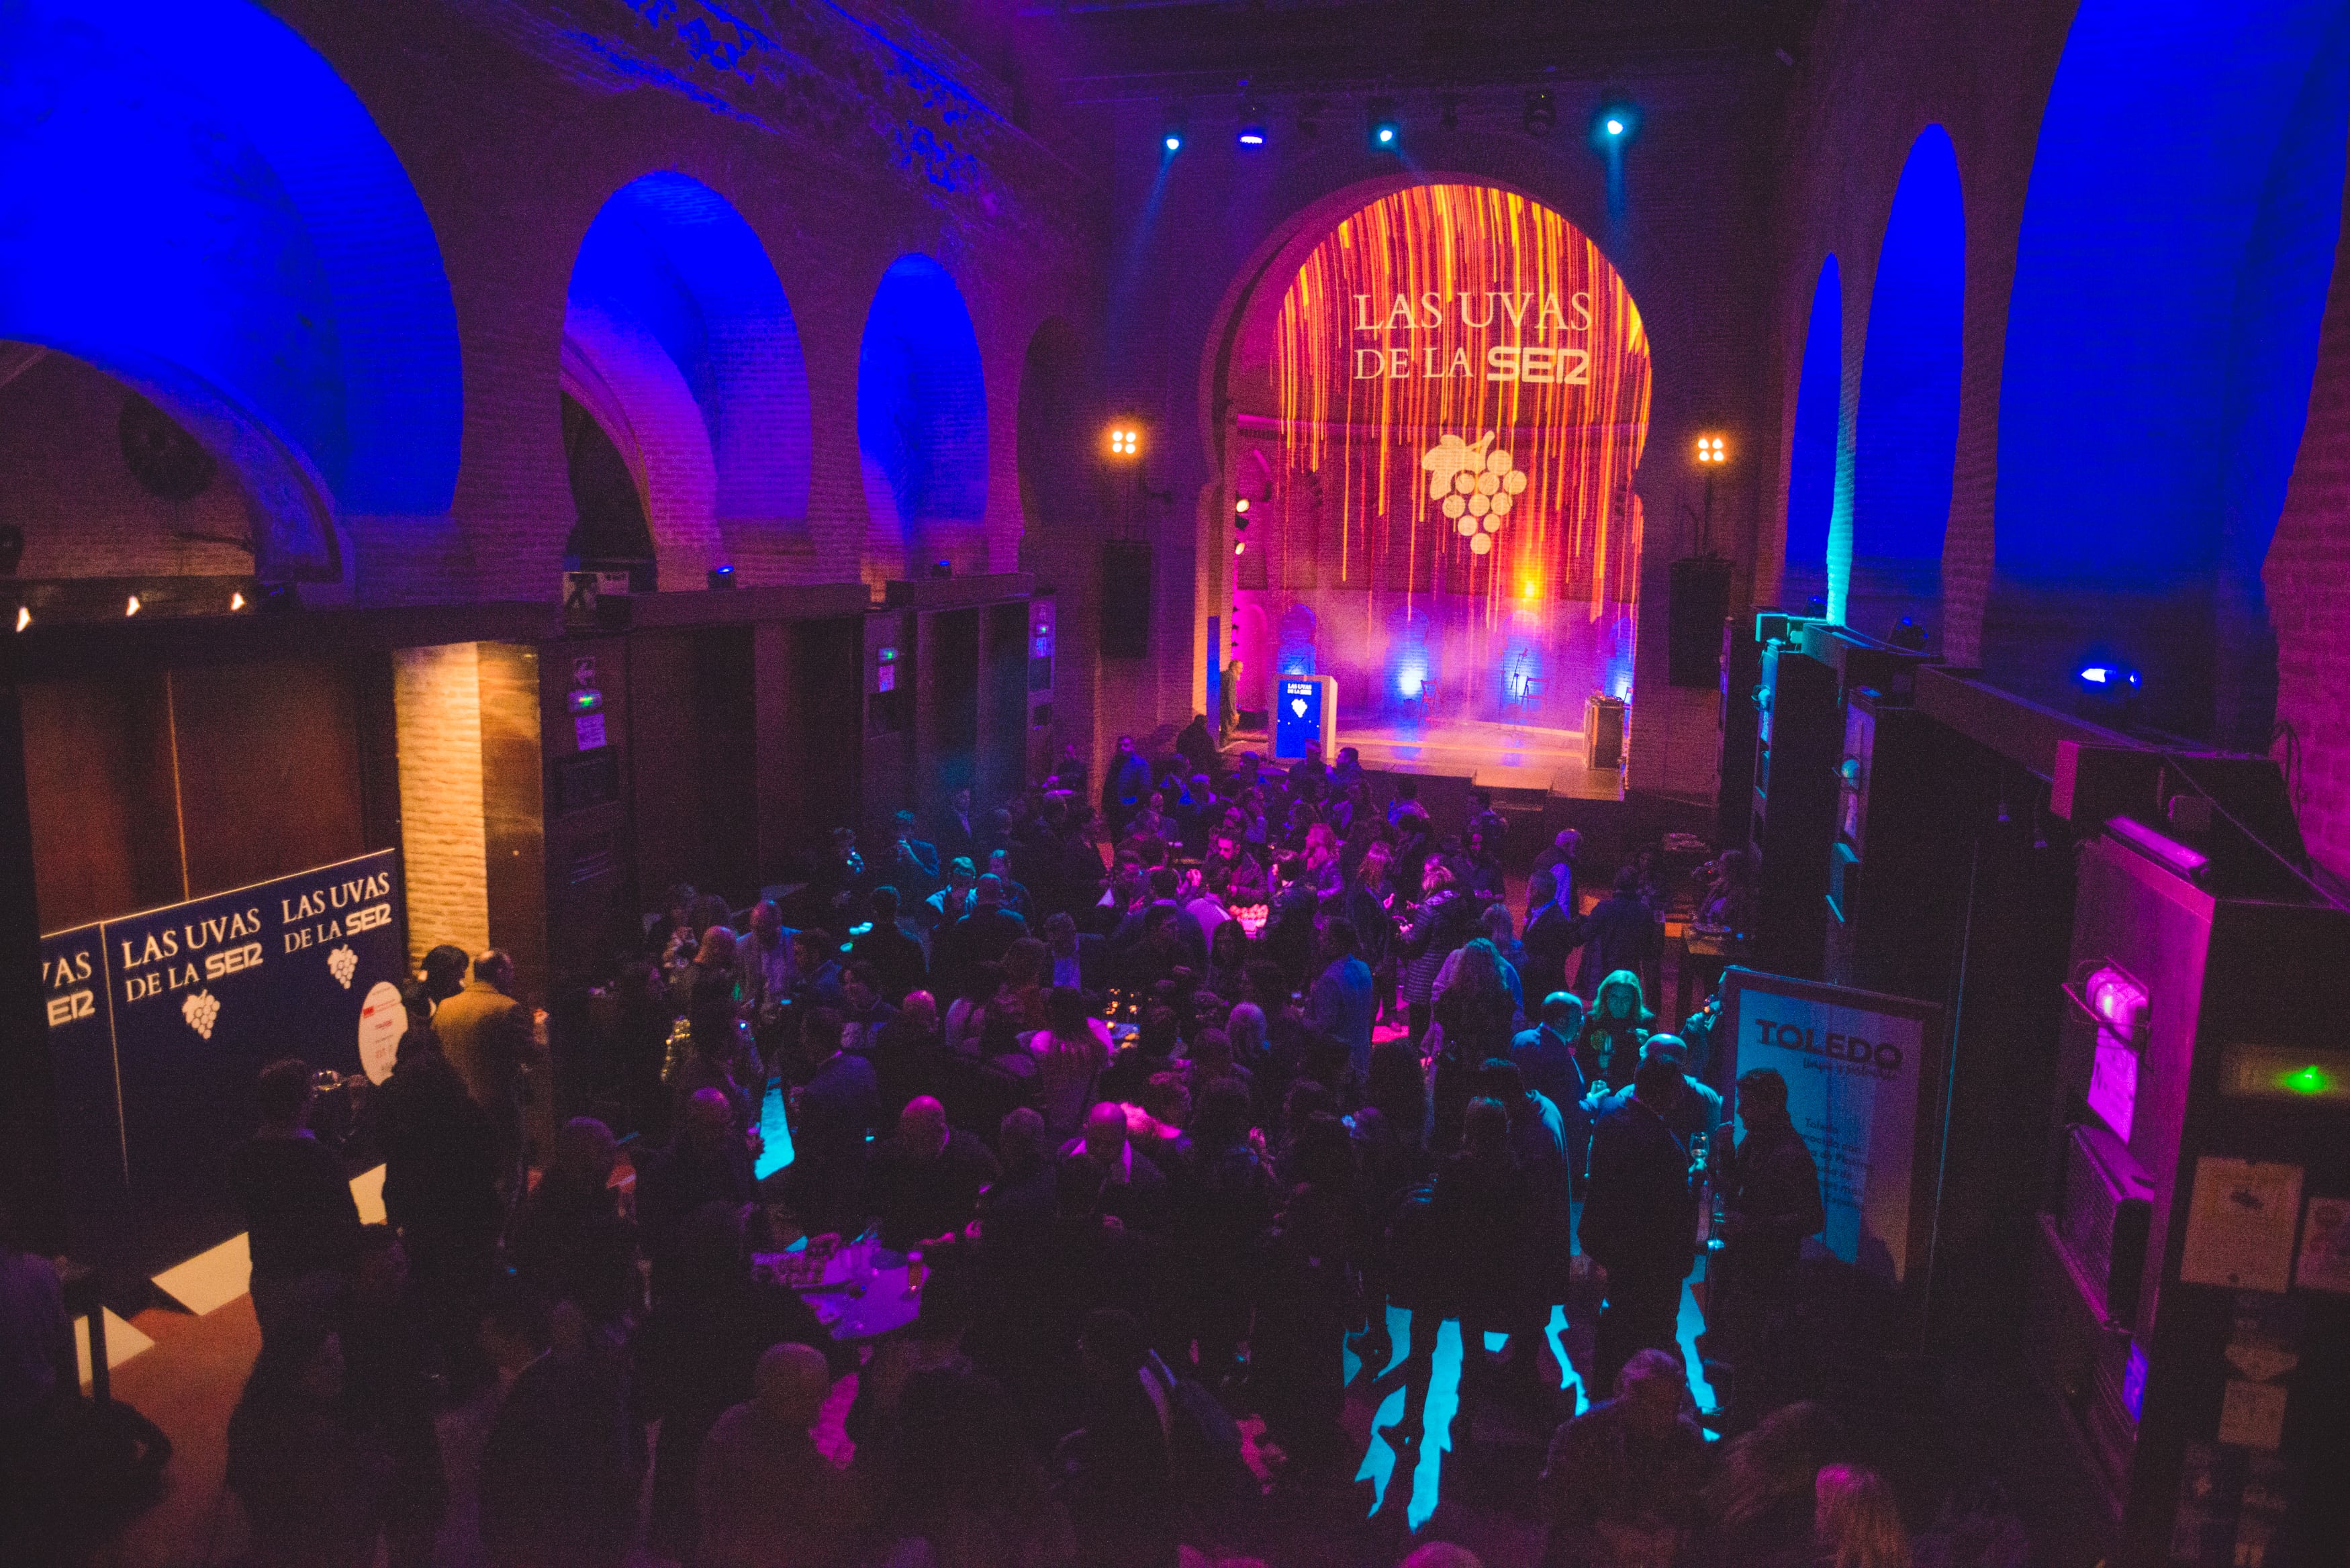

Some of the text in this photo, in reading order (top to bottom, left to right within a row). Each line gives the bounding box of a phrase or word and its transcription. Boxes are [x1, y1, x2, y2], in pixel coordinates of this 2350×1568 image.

[1354, 292, 1593, 330] LAS UVAS
[1354, 346, 1589, 385] DE LA SER
[281, 872, 390, 924] LAS UVAS
[122, 908, 261, 969] LAS UVAS
[284, 903, 392, 954] DE LA SER
[42, 952, 92, 987] AS
[126, 942, 264, 1002] DE LA SER
[1755, 1019, 1903, 1069] TOLEDO
